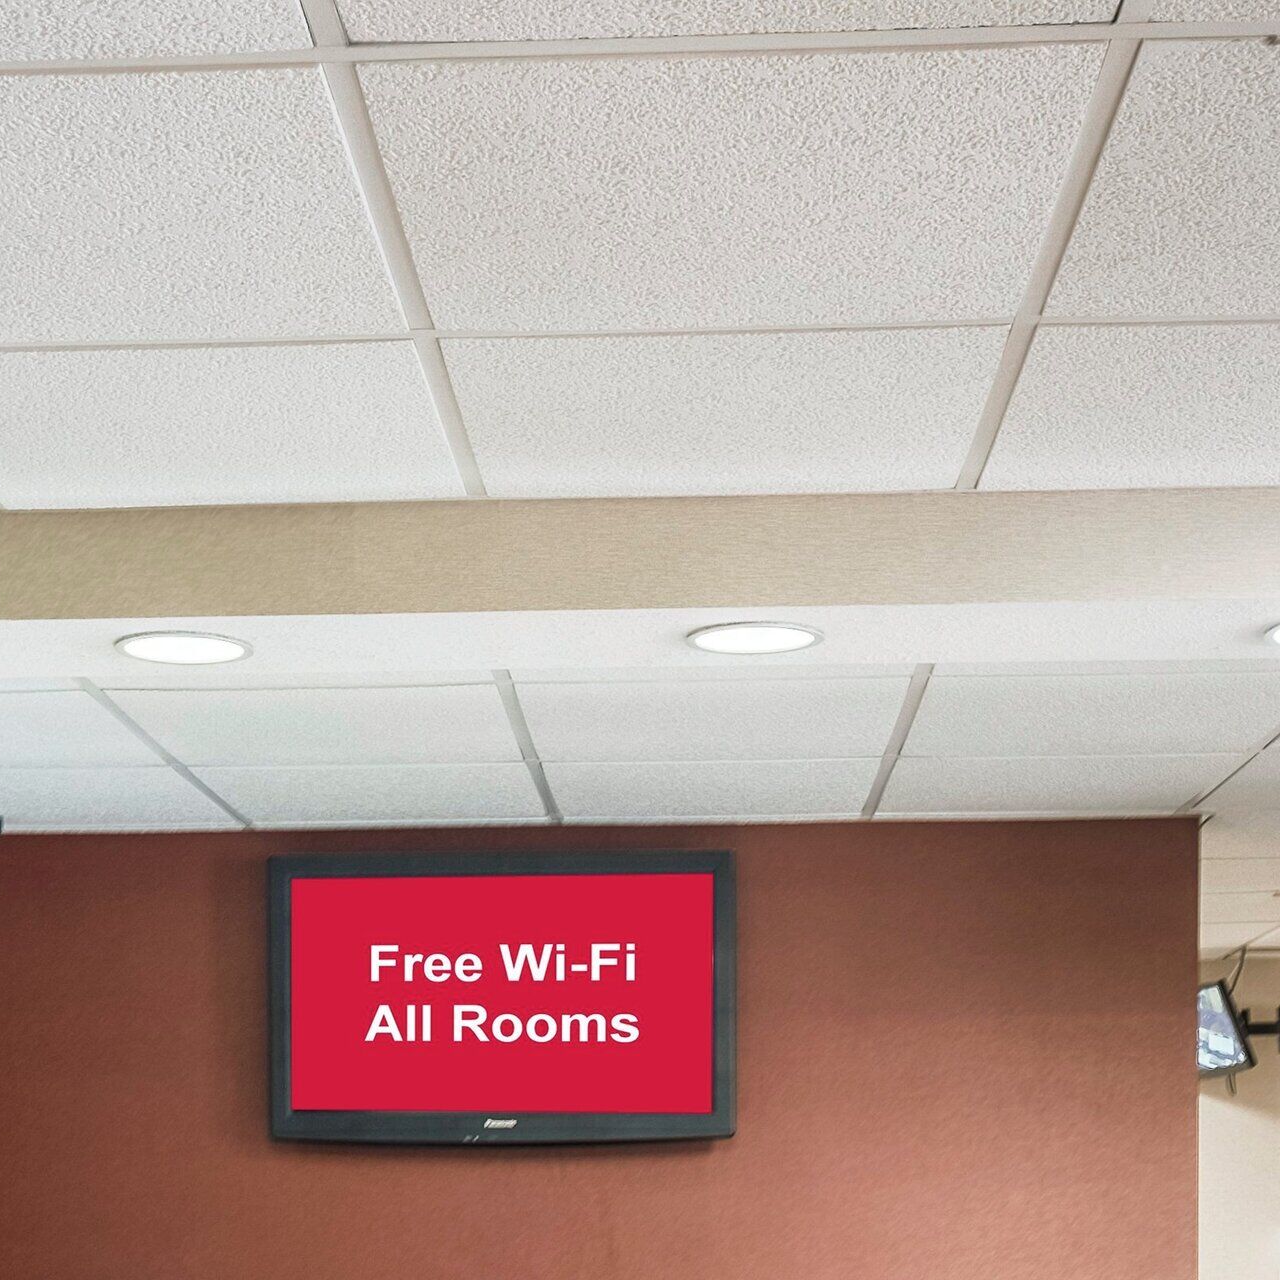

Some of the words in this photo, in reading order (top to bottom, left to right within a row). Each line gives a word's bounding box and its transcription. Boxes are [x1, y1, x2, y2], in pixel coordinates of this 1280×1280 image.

[371, 944, 483, 983] Free
[499, 943, 636, 982] Wi-Fi
[364, 1004, 432, 1042] All
[453, 1004, 640, 1043] Rooms
